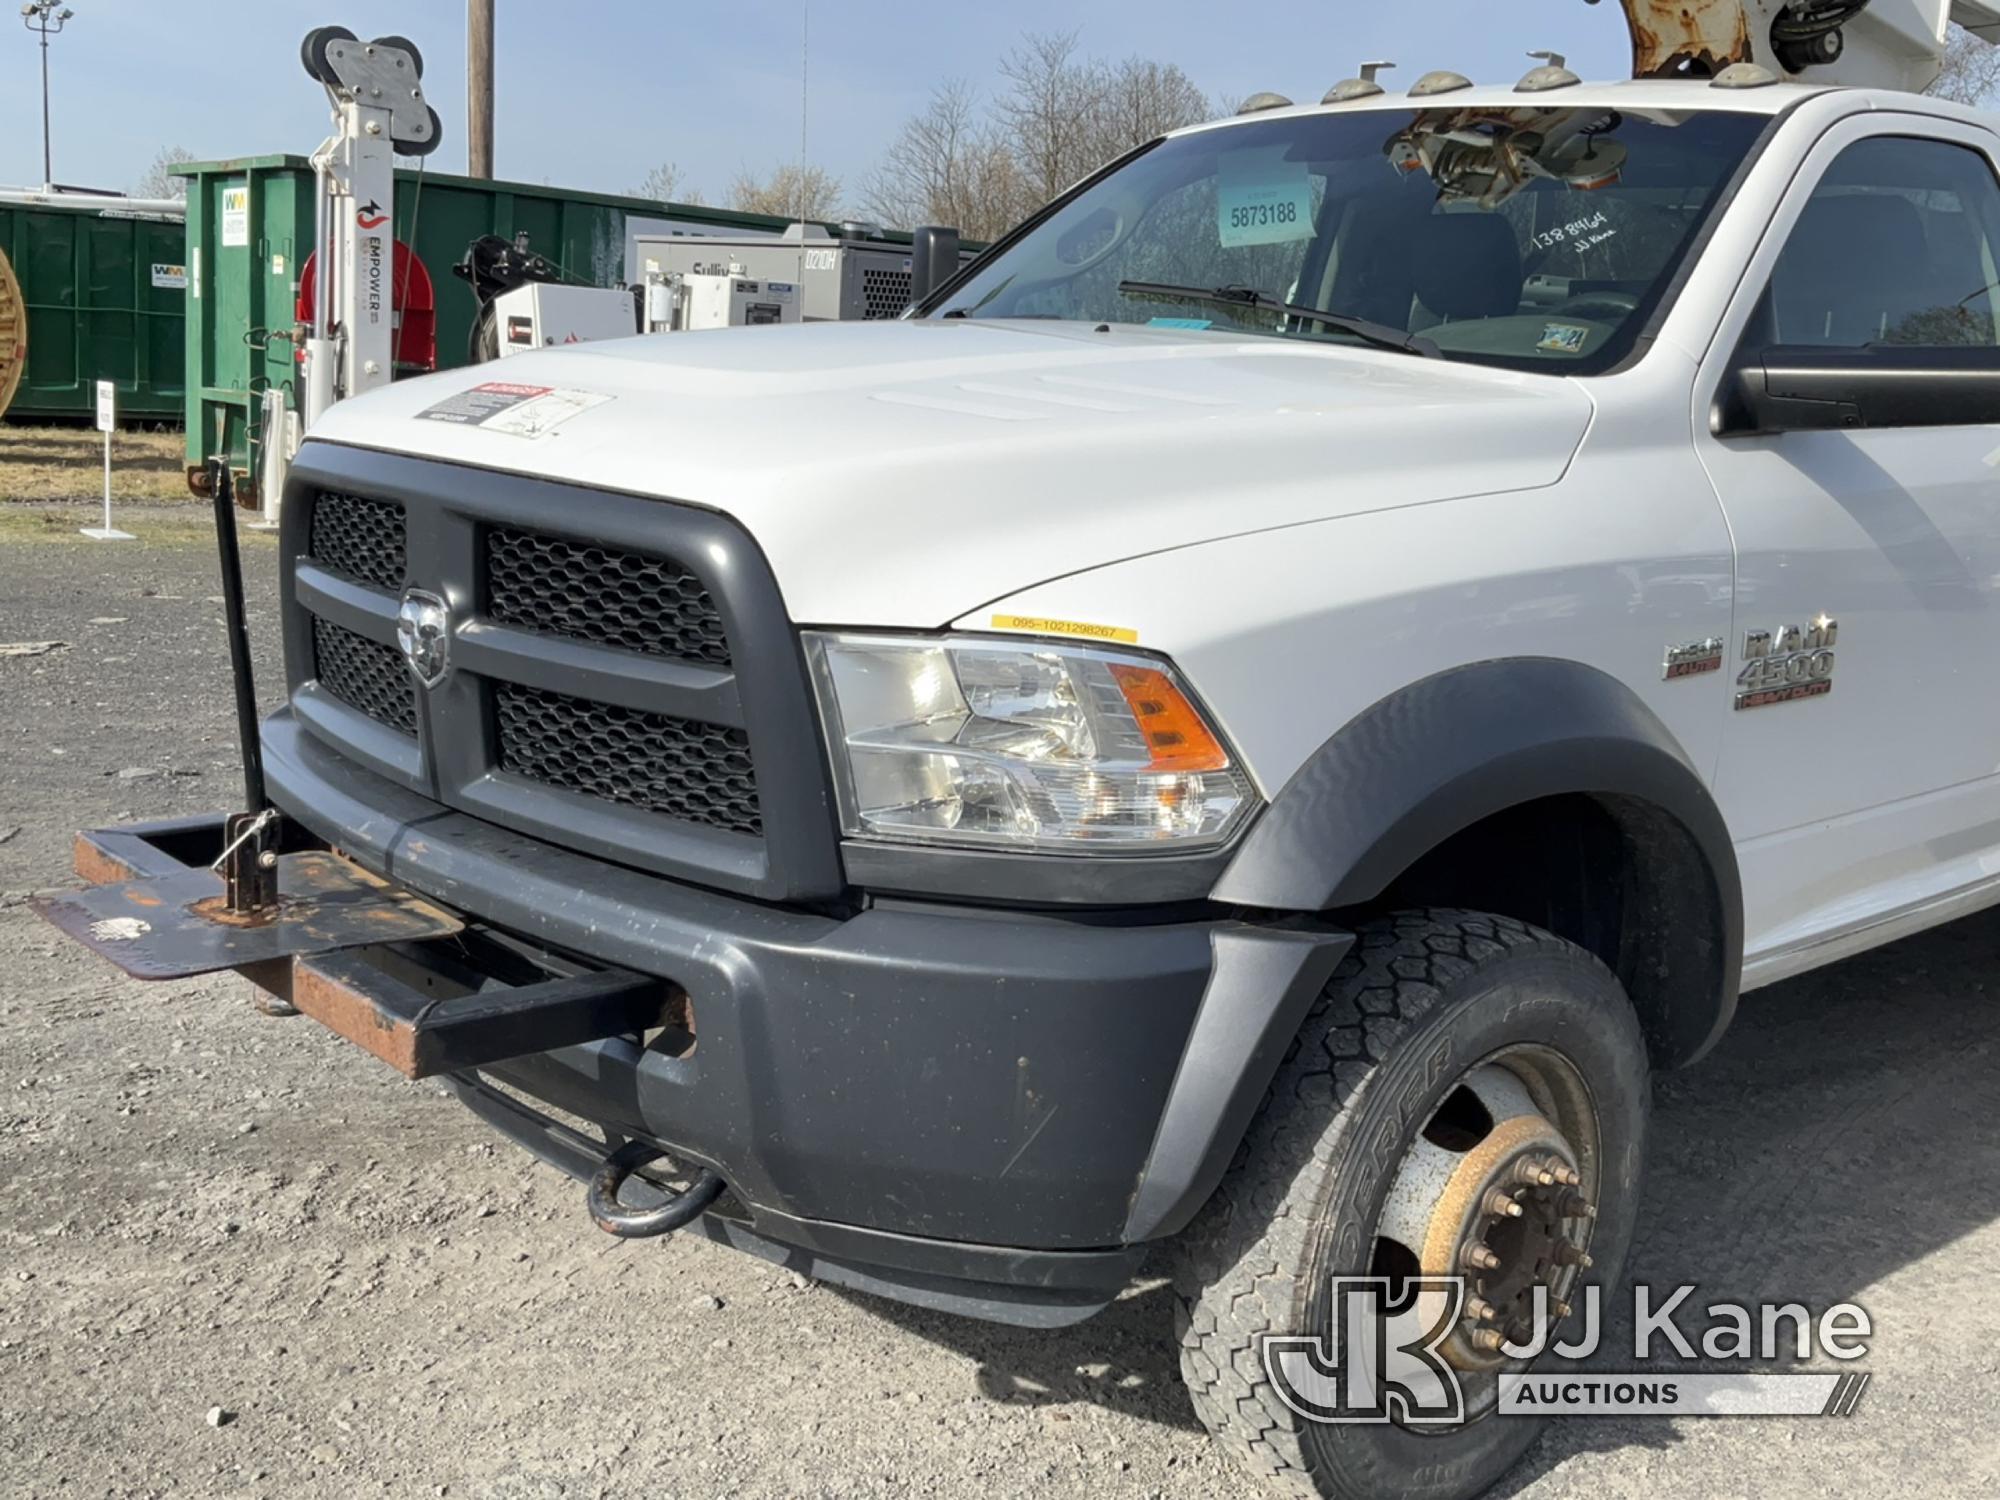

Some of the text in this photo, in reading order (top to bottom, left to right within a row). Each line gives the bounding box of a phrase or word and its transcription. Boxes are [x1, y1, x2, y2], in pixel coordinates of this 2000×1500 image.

[225, 192, 246, 210] WM
[1231, 202, 1297, 228] 5873188
[154, 265, 183, 276] WM
[368, 236, 381, 311] EMPOWER
[1012, 617, 1117, 638] 095-1021298267
[1741, 618, 1838, 660] RAM
[1736, 648, 1834, 689] 4500
[1742, 681, 1830, 708] HEAVY DUTY
